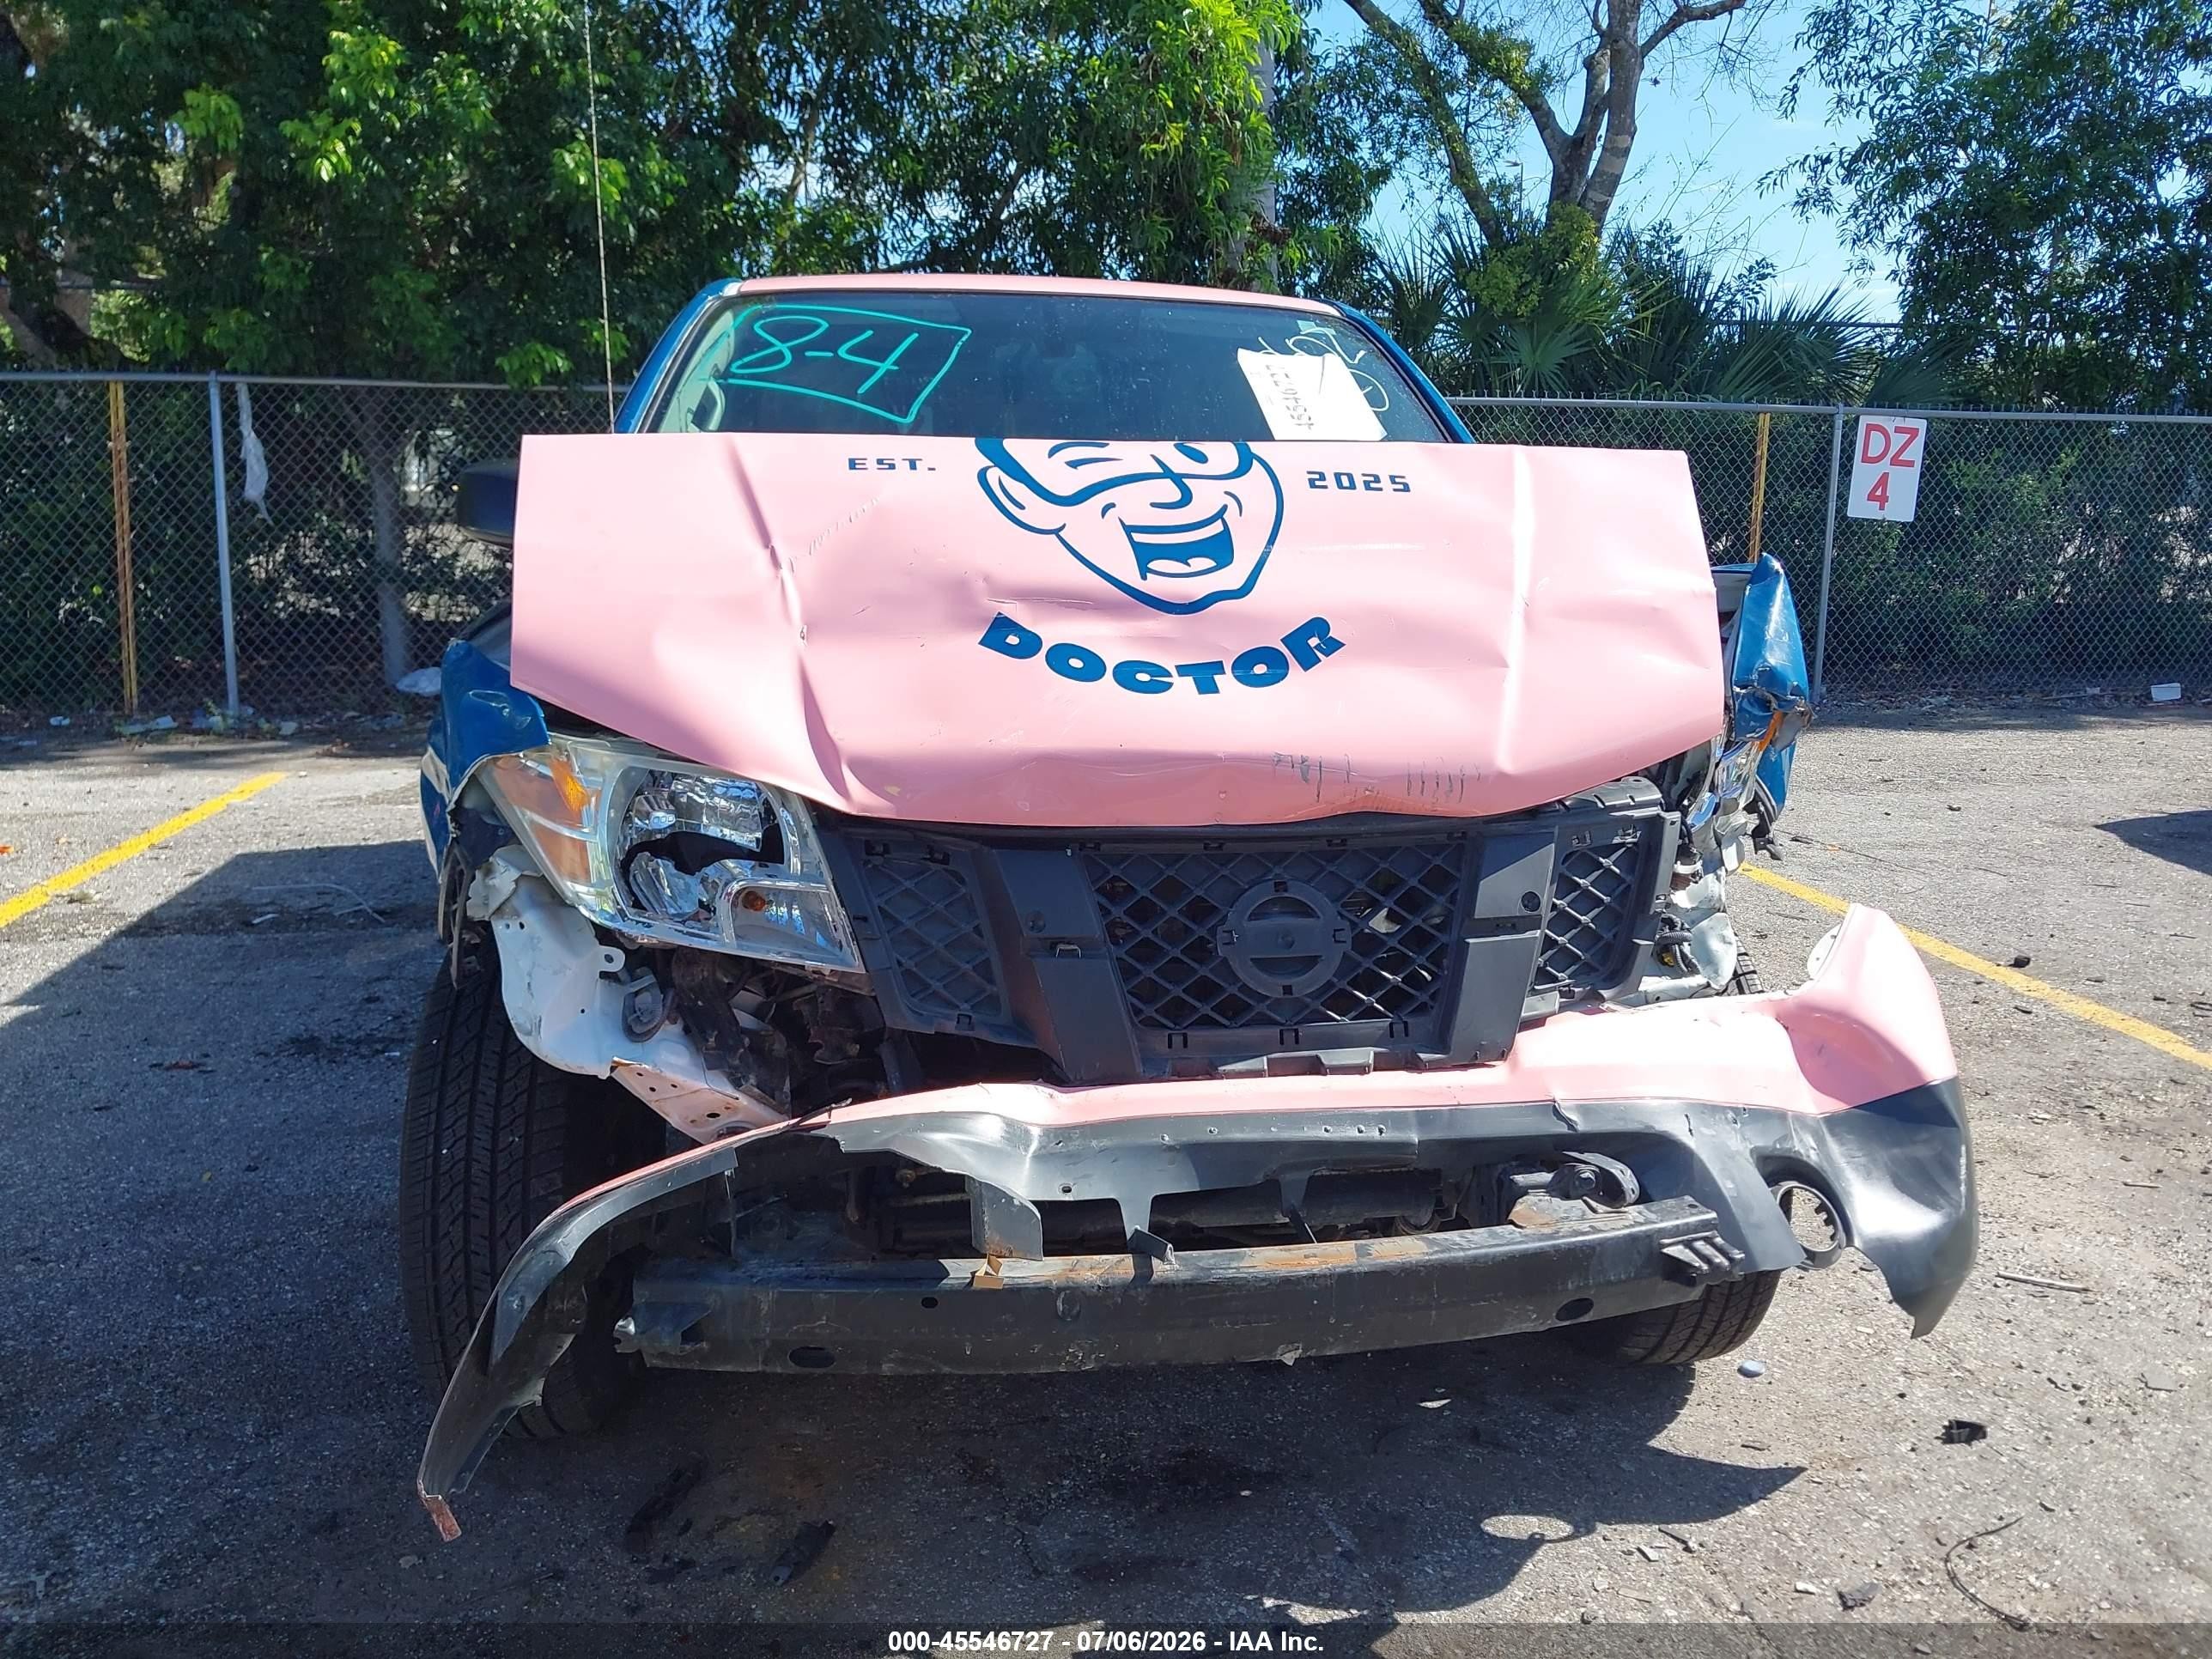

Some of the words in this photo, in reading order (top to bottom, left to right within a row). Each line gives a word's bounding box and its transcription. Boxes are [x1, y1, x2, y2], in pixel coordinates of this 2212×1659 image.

[730, 315, 920, 395] 8-4
[848, 458, 937, 471] EST.
[1861, 422, 1920, 468] DZ
[1306, 470, 1411, 493] 2025
[1867, 471, 1890, 511] 4
[978, 611, 1346, 695] DOCTOR
